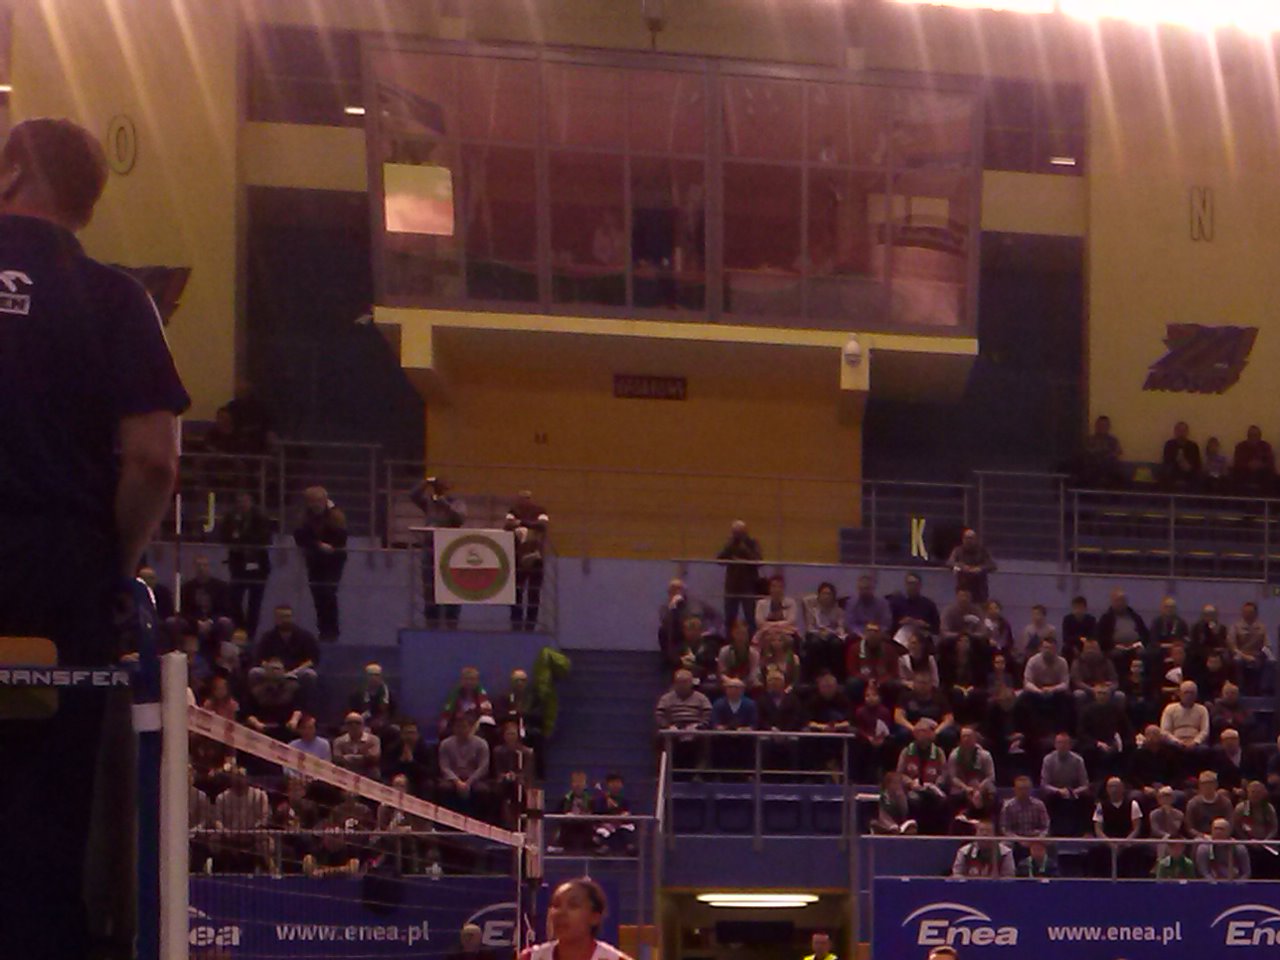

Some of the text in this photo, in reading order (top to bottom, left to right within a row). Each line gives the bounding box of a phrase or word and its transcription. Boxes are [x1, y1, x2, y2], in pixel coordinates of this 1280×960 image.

[1190, 185, 1214, 243] N
[203, 492, 216, 533] J
[911, 517, 928, 562] K
[276, 920, 430, 945] www.enea.pl
[917, 919, 1018, 946] Enea
[1048, 921, 1183, 945] www.enea.pl
